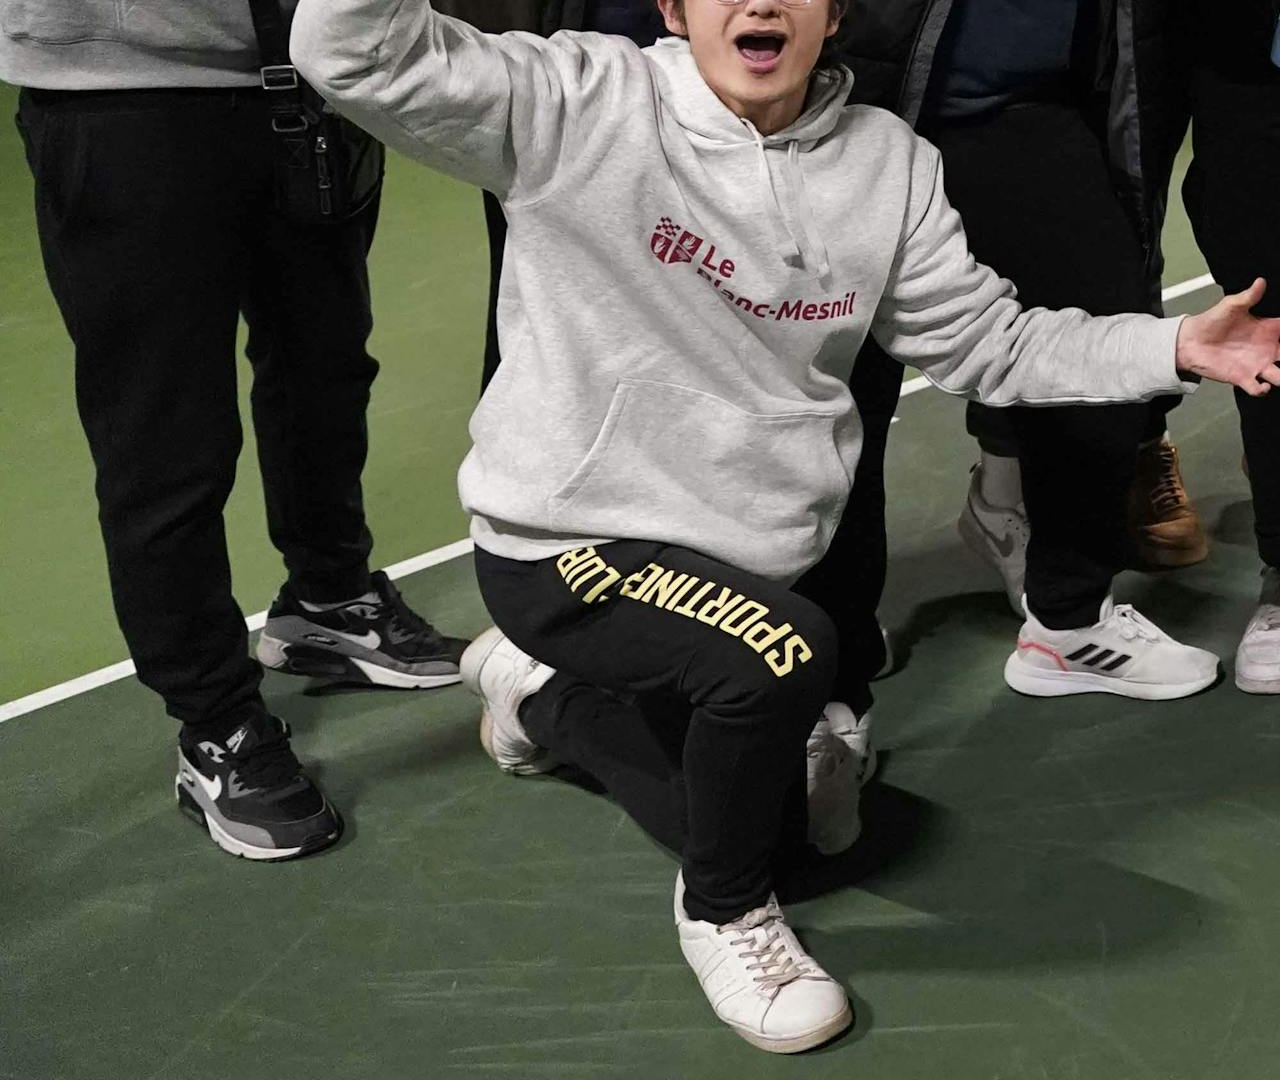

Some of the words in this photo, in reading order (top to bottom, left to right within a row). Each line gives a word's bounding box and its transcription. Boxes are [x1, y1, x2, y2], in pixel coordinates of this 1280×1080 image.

[701, 244, 736, 279] Le
[555, 545, 623, 605] LUB
[619, 562, 814, 679] SPORTING
